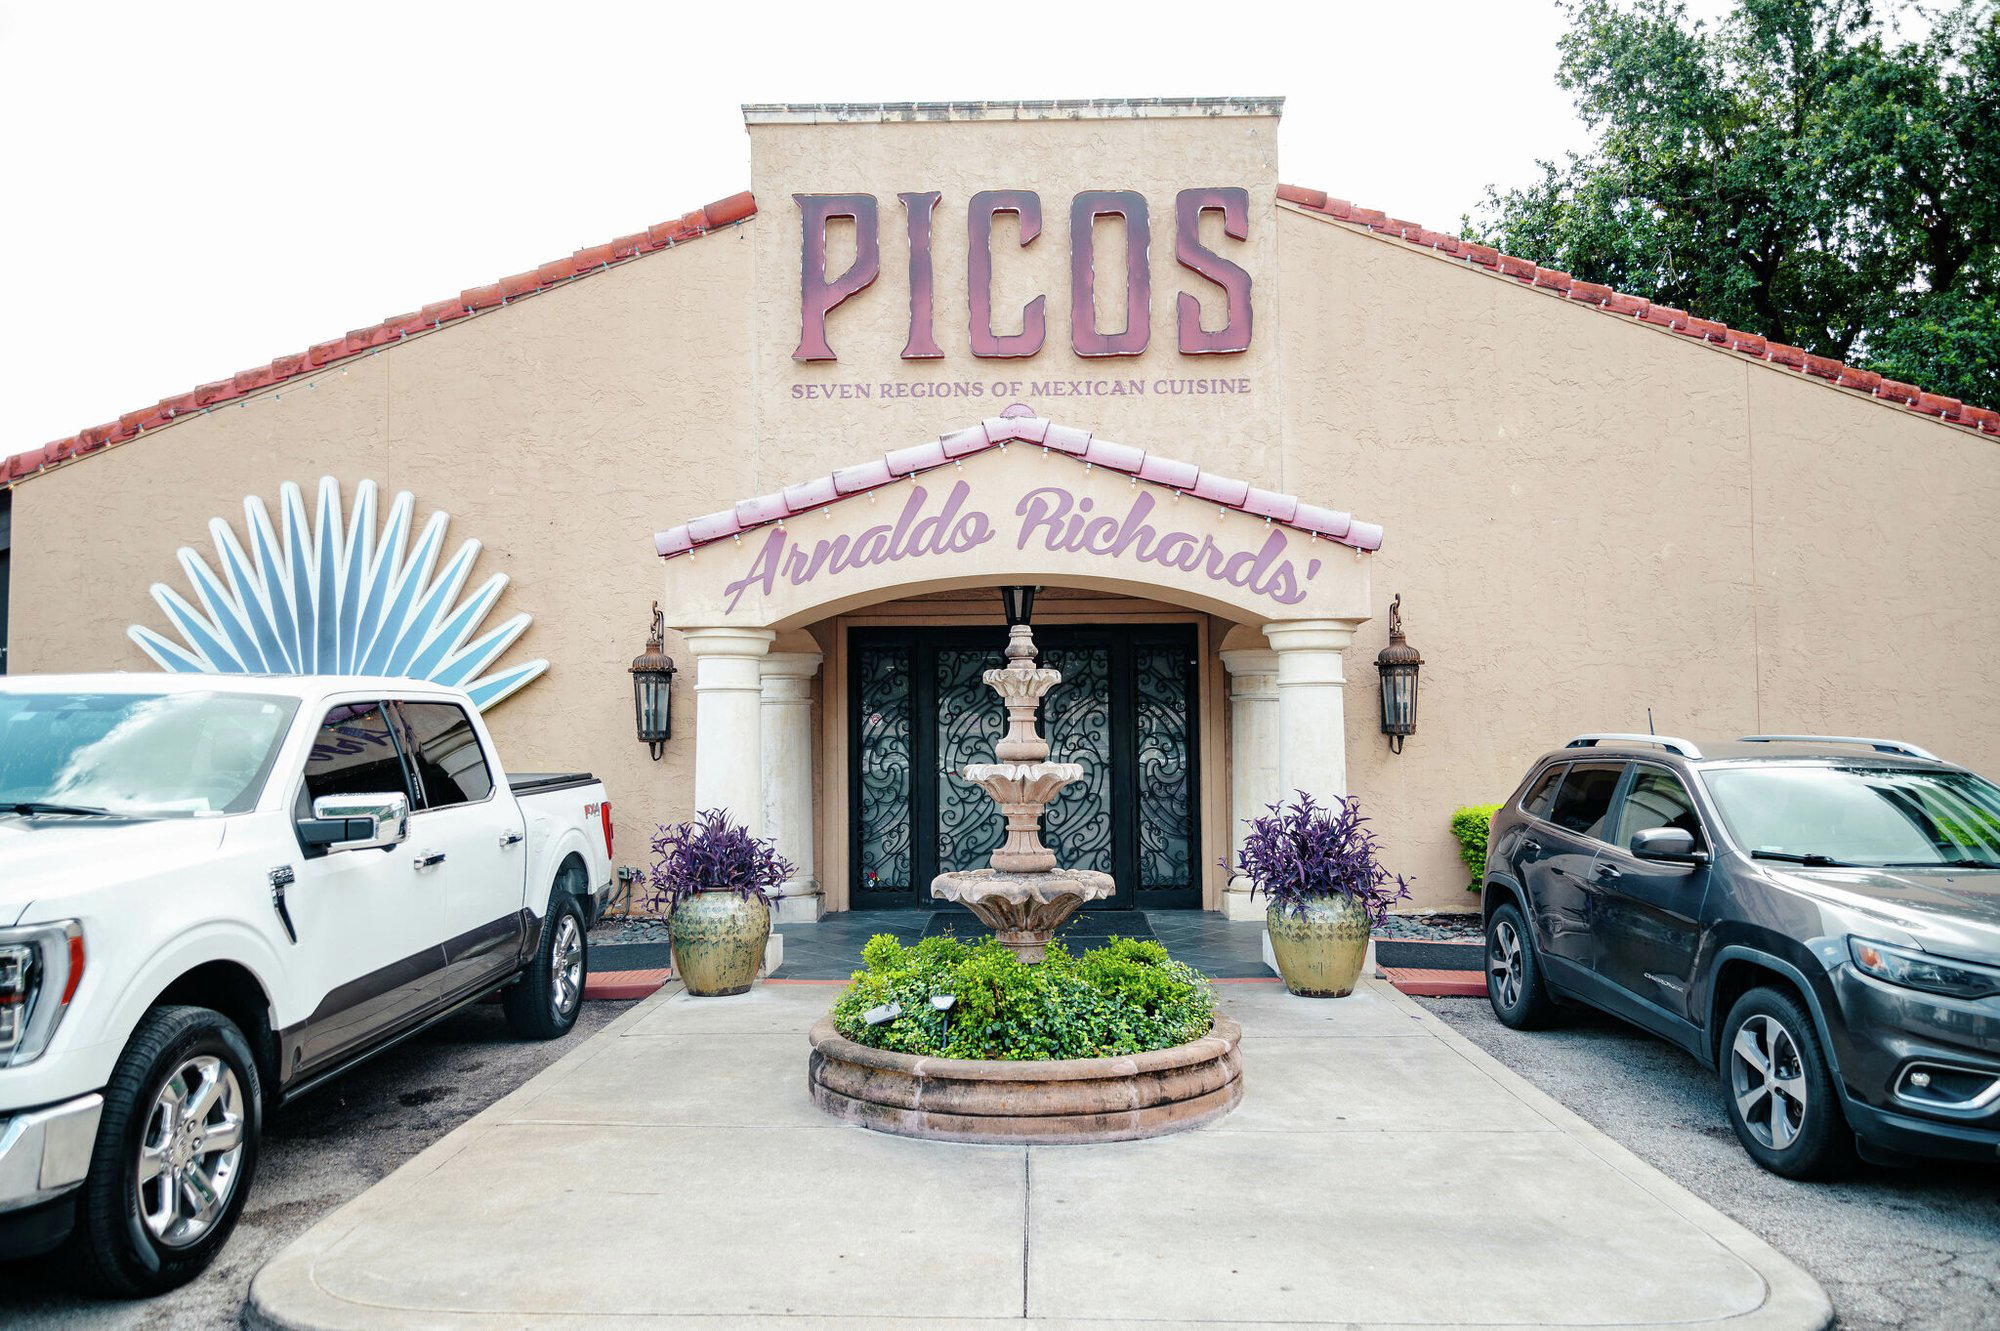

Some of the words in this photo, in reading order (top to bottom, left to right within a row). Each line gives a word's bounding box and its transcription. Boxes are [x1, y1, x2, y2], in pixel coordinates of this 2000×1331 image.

[792, 187, 1253, 362] PICOS
[791, 383, 871, 399] SEVEN
[880, 381, 984, 398] REGIONS
[991, 381, 1023, 397] OF
[1030, 380, 1145, 397] MEXICAN
[1153, 378, 1252, 395] CUISINE
[724, 480, 995, 614] Arnaldo
